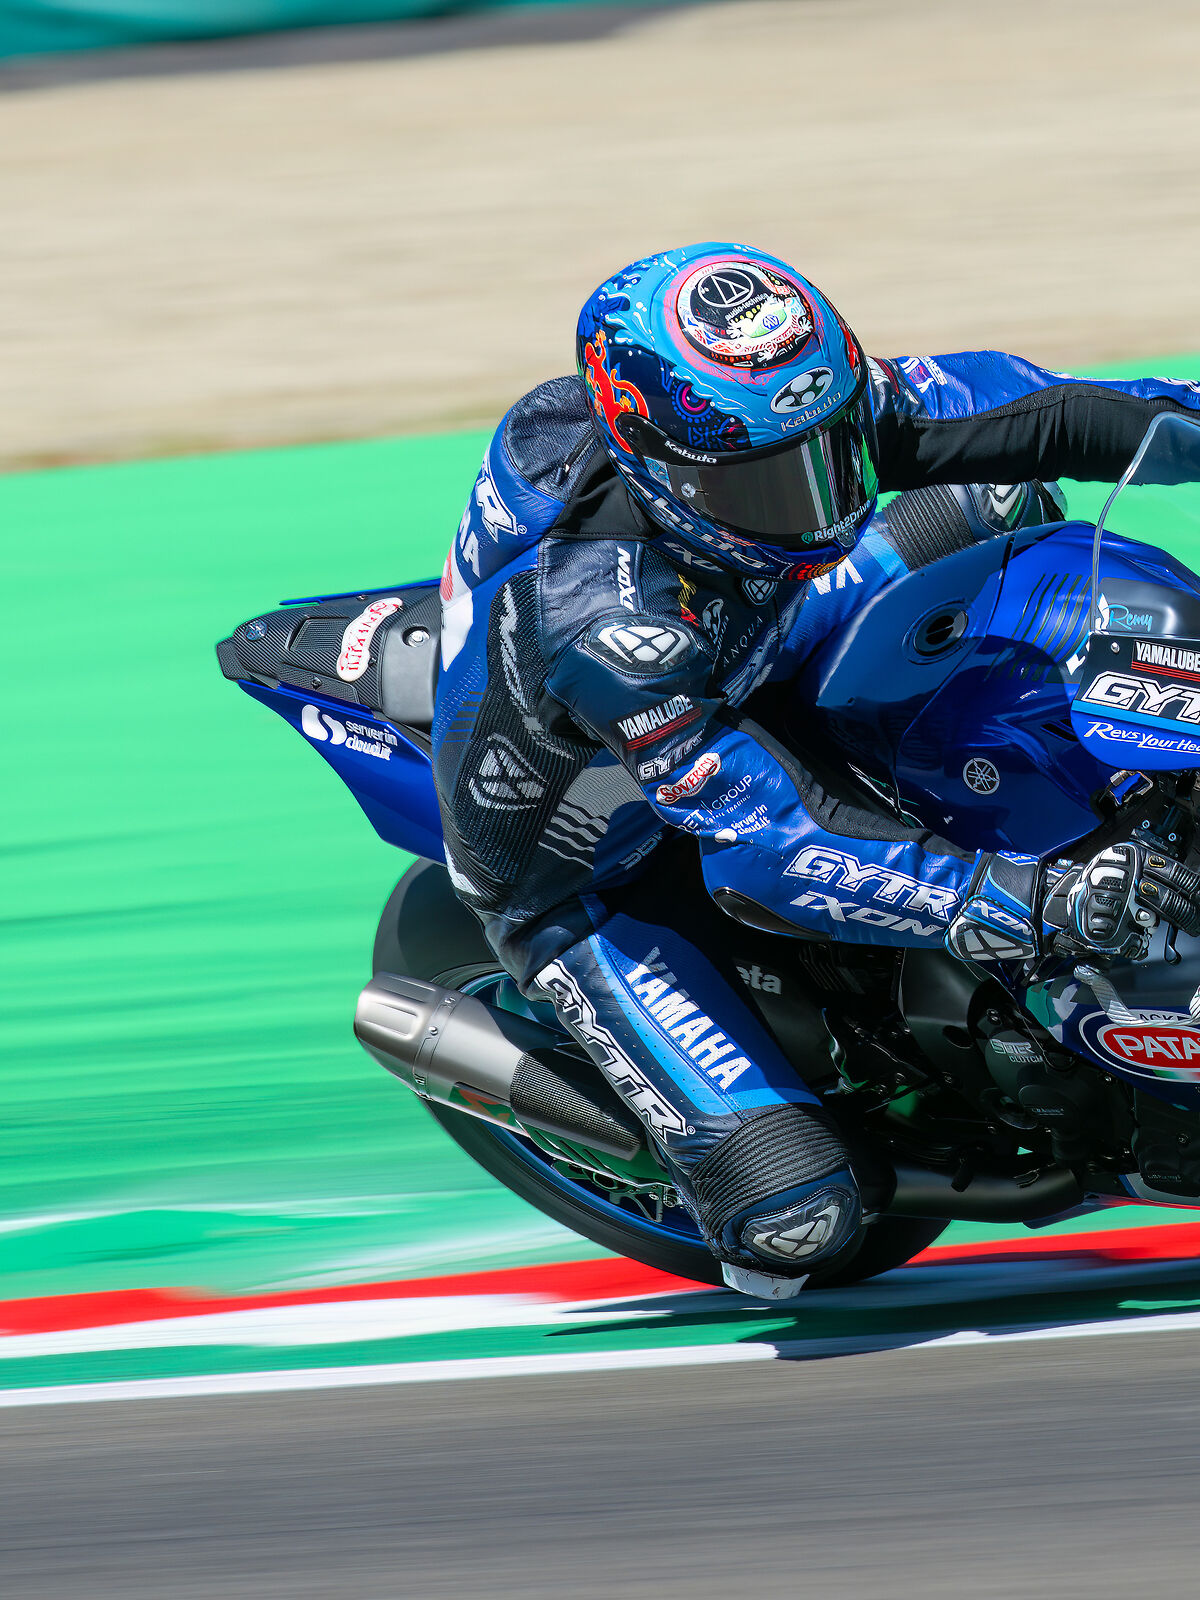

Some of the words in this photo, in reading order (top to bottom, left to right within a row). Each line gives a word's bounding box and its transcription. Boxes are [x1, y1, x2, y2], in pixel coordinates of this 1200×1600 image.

[781, 392, 841, 432] Kabuto
[664, 440, 717, 464] Kabuto
[617, 694, 694, 740] YAMALUBE
[712, 775, 752, 810] GROUP
[782, 844, 961, 922] GYTR
[625, 947, 751, 1090] YAMAHA
[533, 958, 687, 1143] GYTR
